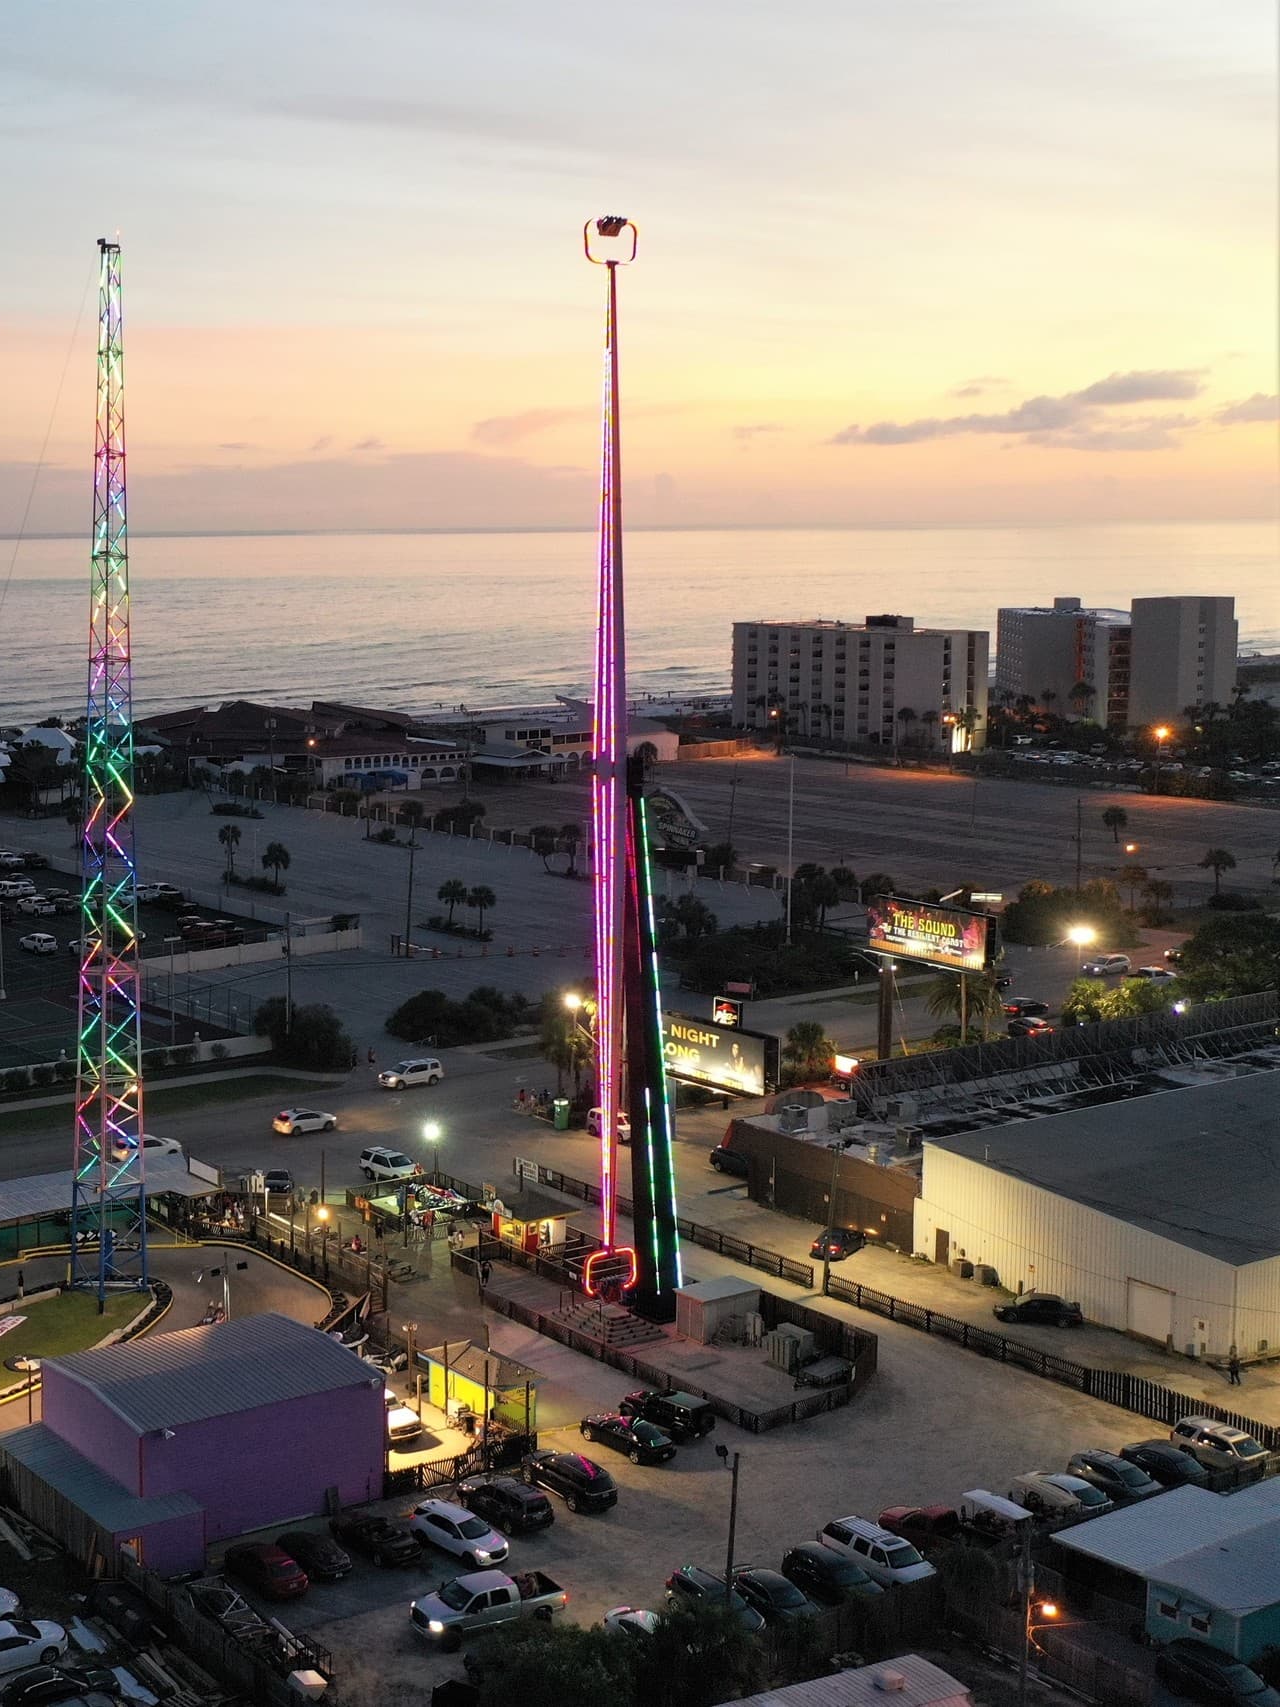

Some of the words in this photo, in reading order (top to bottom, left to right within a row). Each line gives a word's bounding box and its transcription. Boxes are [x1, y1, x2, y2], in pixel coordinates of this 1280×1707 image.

[893, 912, 915, 930] THE
[918, 918, 956, 938] SOUND
[893, 926, 906, 936] THE
[941, 936, 964, 948] COAST
[671, 1024, 720, 1048] NIGHT
